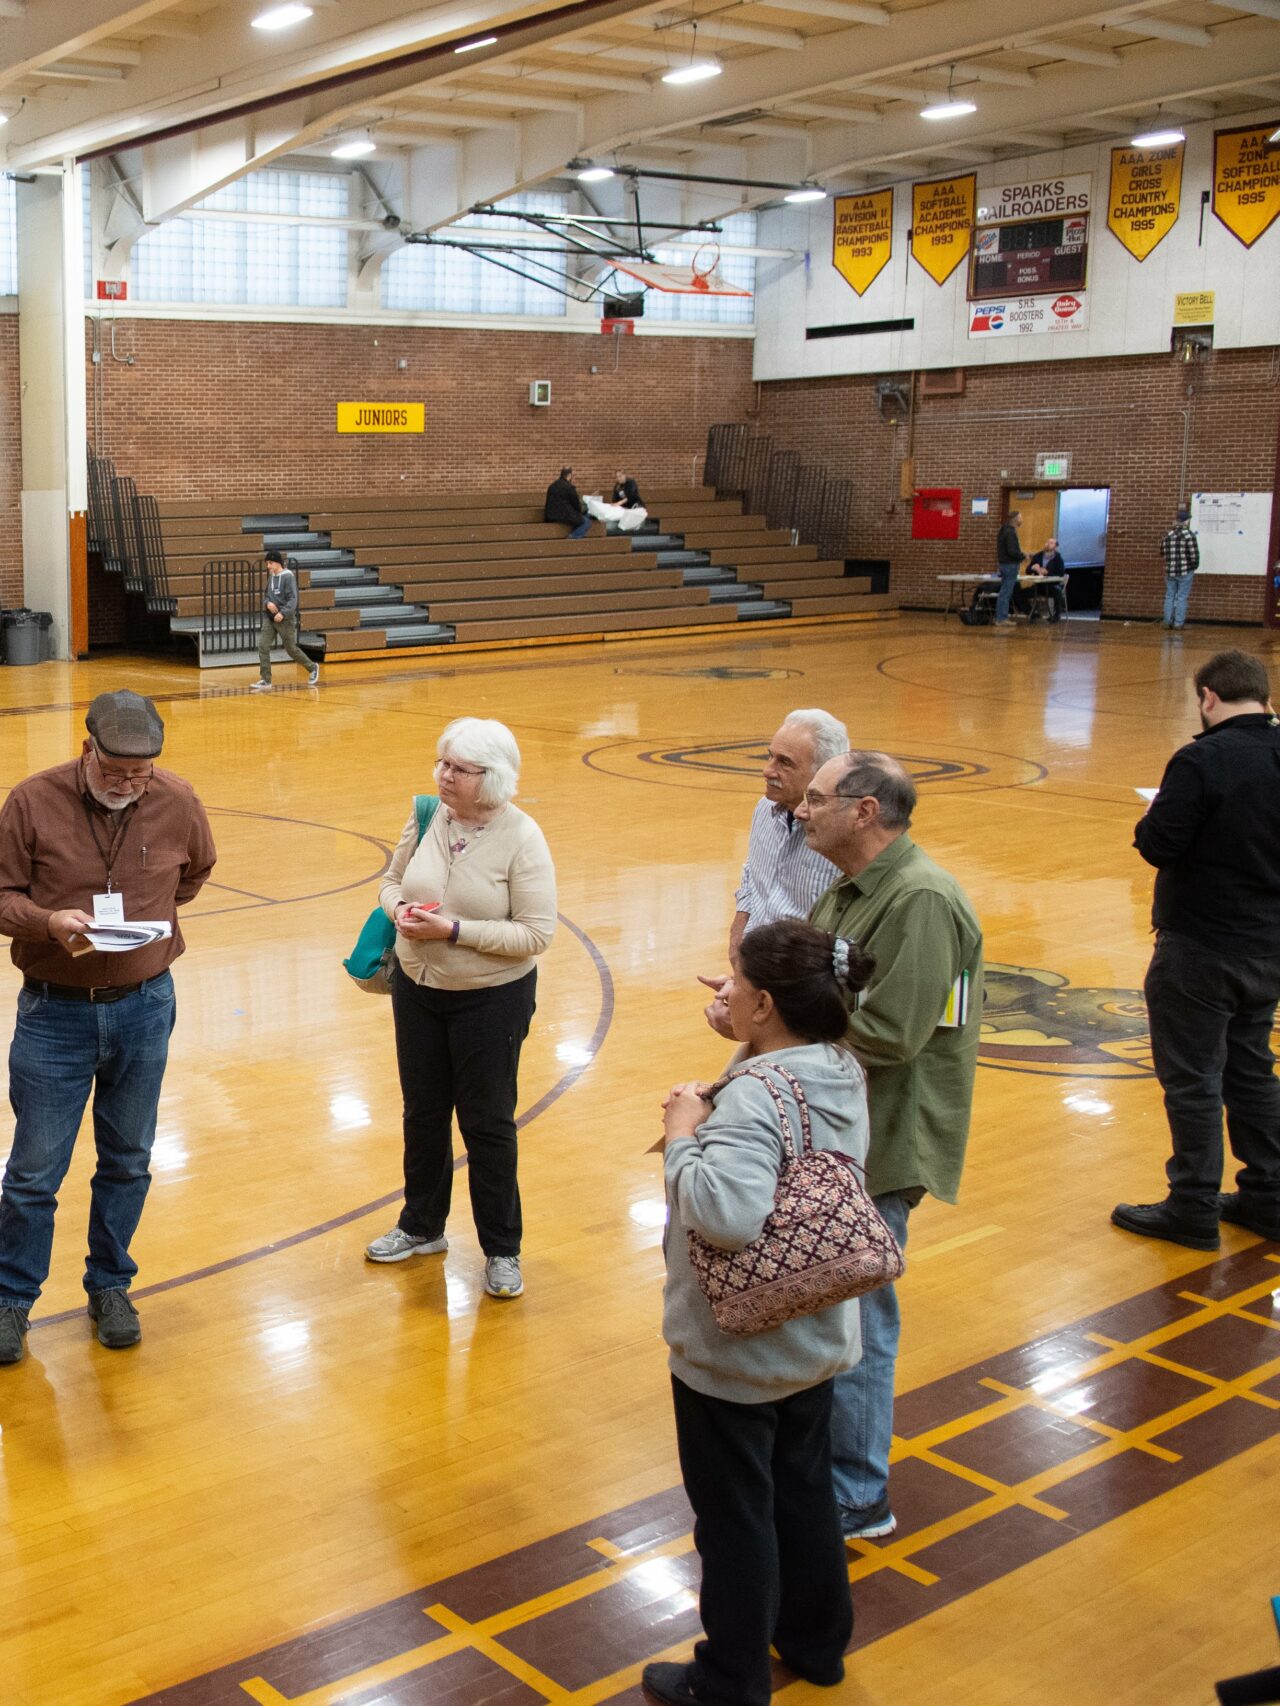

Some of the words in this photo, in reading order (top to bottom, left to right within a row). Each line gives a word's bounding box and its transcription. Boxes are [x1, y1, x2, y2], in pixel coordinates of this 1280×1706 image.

[1120, 154, 1144, 165] AAA
[1149, 148, 1177, 162] ZONE
[1131, 164, 1162, 178] GIRLS
[1222, 161, 1280, 179] SOFTBALL
[1129, 178, 1162, 191] CROSS
[1217, 174, 1280, 193] CHAMPION
[933, 185, 955, 197] AAA
[1002, 181, 1064, 203] SPARKS
[1121, 190, 1167, 205] COUNTRY
[1237, 191, 1266, 205] 1995
[853, 200, 874, 210] AAA
[920, 195, 967, 211] SOFTBALL
[919, 207, 967, 223] ACADEMIC
[1113, 203, 1175, 218] CHAMPIONS
[839, 212, 877, 224] DIVISION
[1131, 219, 1155, 231] 1995
[836, 221, 890, 235] BASKETBALL
[914, 219, 970, 236] CHAMPIONS
[837, 232, 889, 246] CHAMPIONS
[931, 234, 954, 246] 1993
[851, 247, 872, 257] 1993
[1054, 245, 1082, 255] GUEST
[979, 254, 1003, 264] HOME
[975, 305, 1006, 315] PEPSI
[1009, 310, 1044, 321] BOOSTERS
[1019, 323, 1033, 332] 1992
[355, 409, 408, 426] JUNIORS
